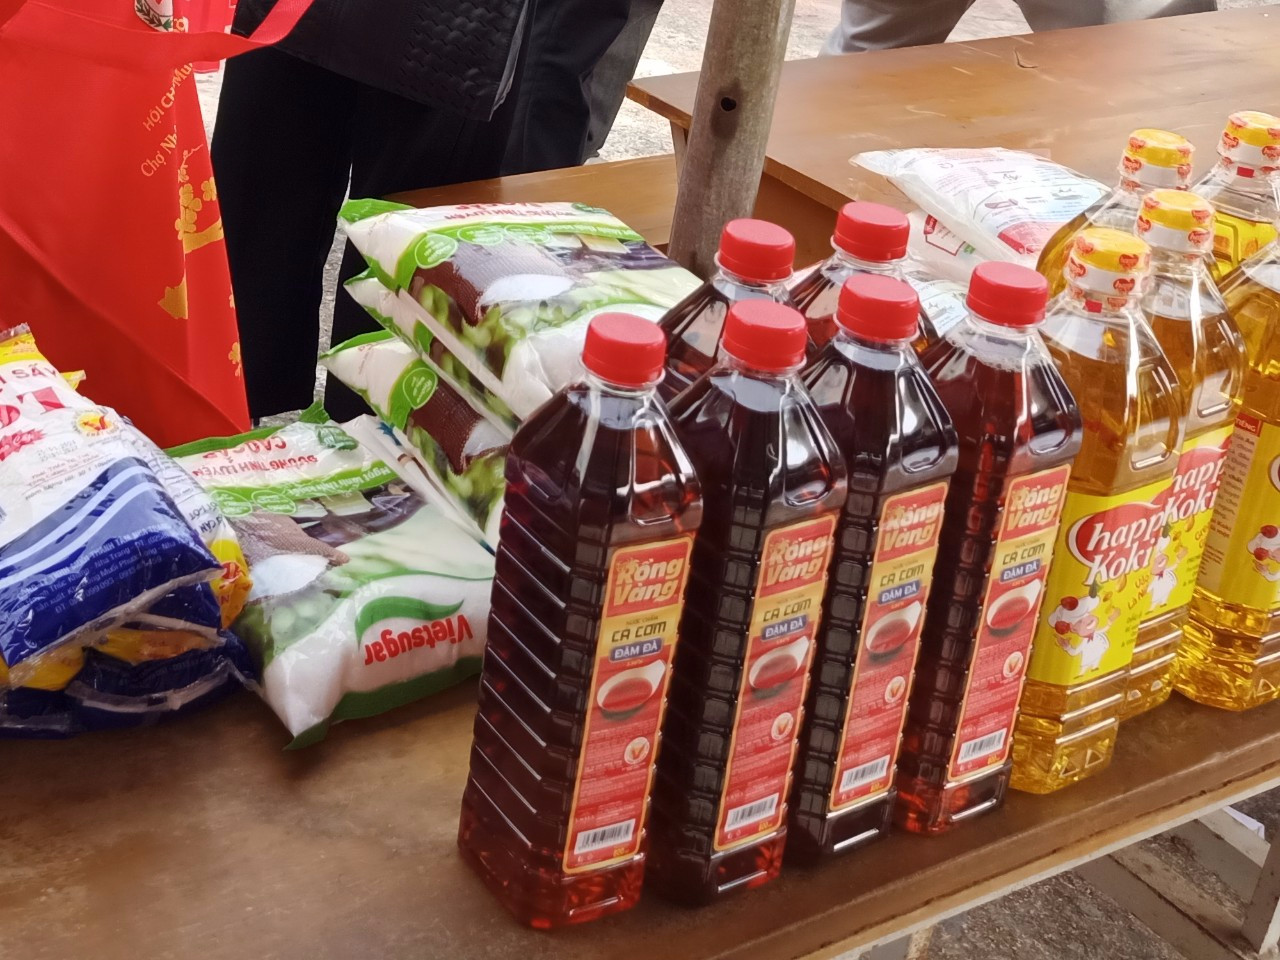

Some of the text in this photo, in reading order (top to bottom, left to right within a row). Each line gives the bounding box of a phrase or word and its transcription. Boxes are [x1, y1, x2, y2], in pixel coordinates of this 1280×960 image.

[143, 105, 165, 131] HỘI
[141, 151, 166, 177] Chợ
[1172, 454, 1226, 495] happ
[1012, 484, 1063, 512] Rồng
[886, 503, 941, 528] Rồng
[1007, 505, 1054, 531] Vàng
[884, 525, 935, 551] Vàng
[1086, 507, 1167, 552] happ
[768, 536, 830, 565] Rồng
[1083, 536, 1155, 587] Koki
[616, 558, 685, 585] Rồng
[765, 557, 824, 586] Vàng
[613, 580, 679, 606] Vàng
[364, 614, 473, 666] Vietsugar
[642, 641, 658, 653] ĐÀ
